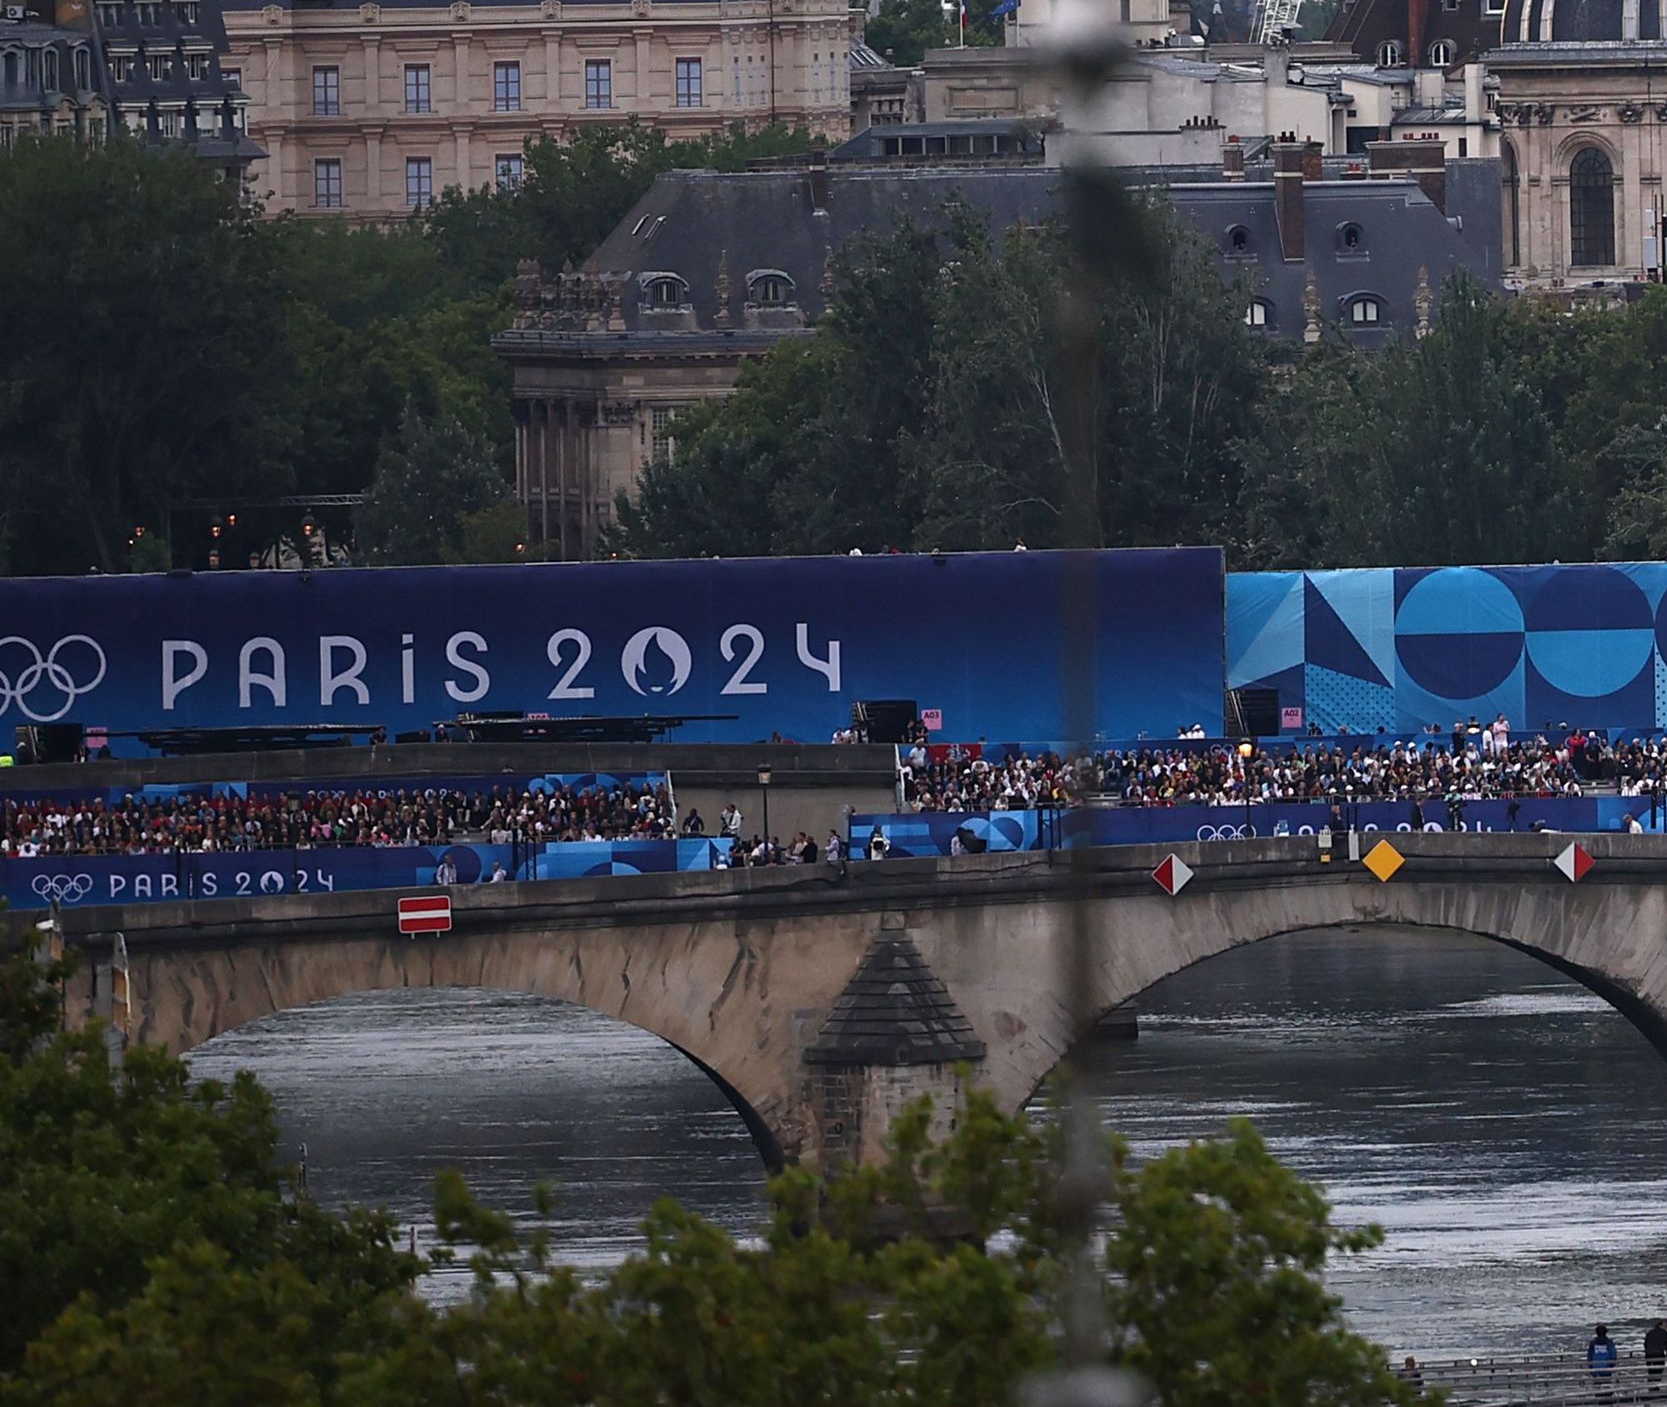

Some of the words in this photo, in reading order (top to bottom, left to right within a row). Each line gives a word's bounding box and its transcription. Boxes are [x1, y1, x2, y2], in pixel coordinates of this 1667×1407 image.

[163, 631, 490, 710] PARIS
[547, 623, 841, 700] 2024
[924, 711, 939, 719] A03
[110, 873, 218, 898] PARIS
[235, 869, 333, 895] 2024
